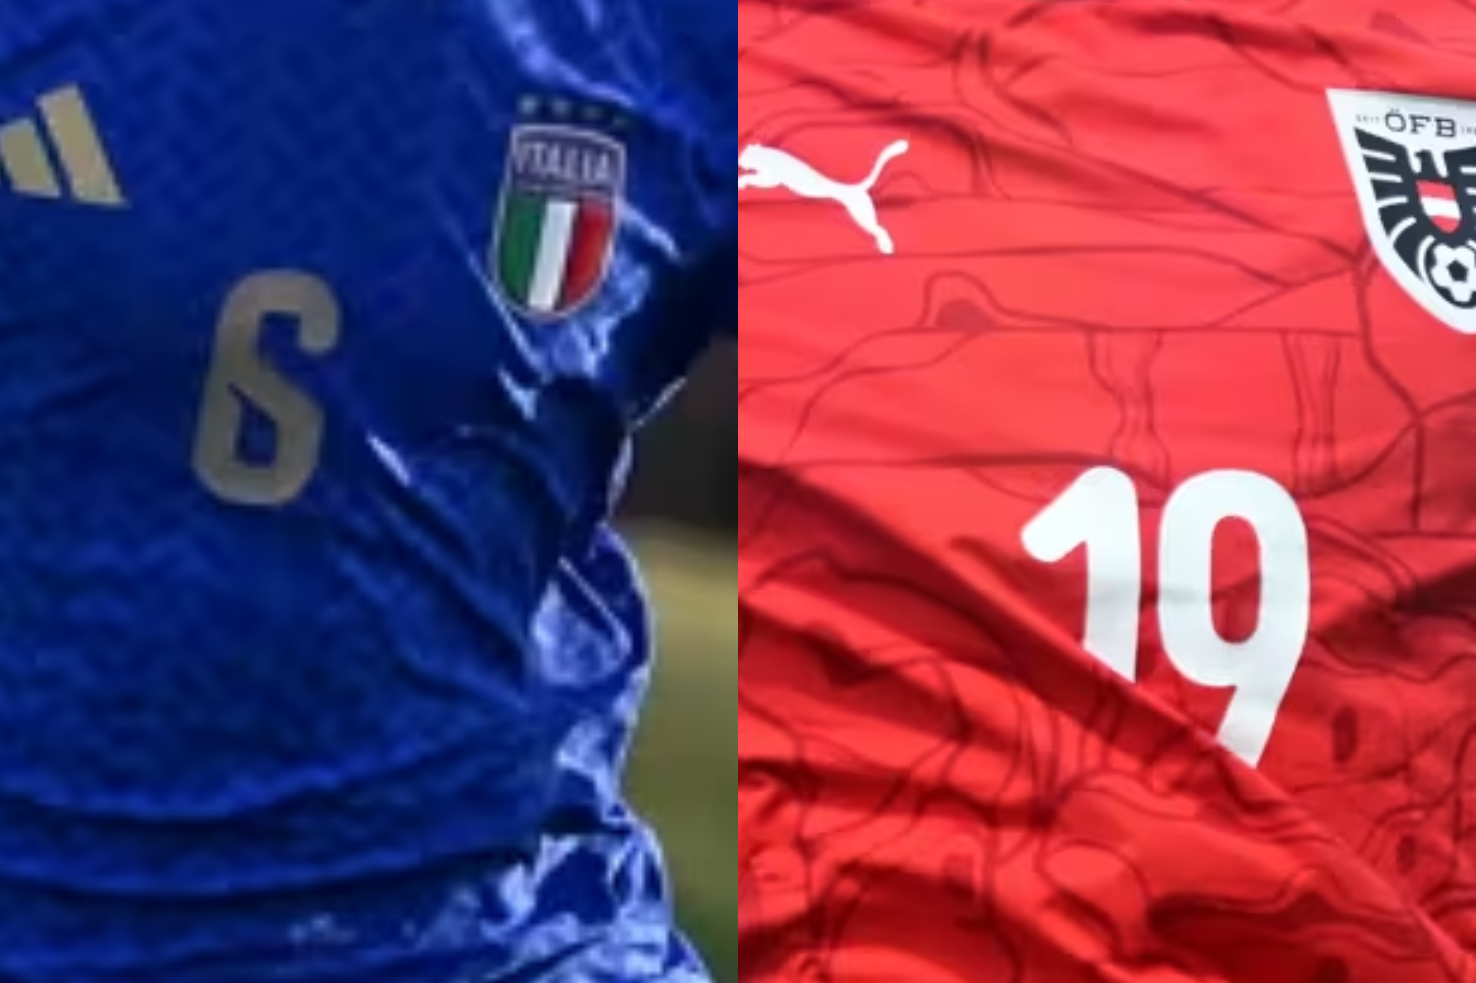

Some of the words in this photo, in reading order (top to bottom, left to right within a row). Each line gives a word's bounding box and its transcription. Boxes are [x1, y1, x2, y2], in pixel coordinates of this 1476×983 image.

[513, 142, 612, 181] ITALIA
[1384, 108, 1456, 138] ÖFB
[191, 267, 342, 506] 6
[1020, 465, 1311, 770] 19
